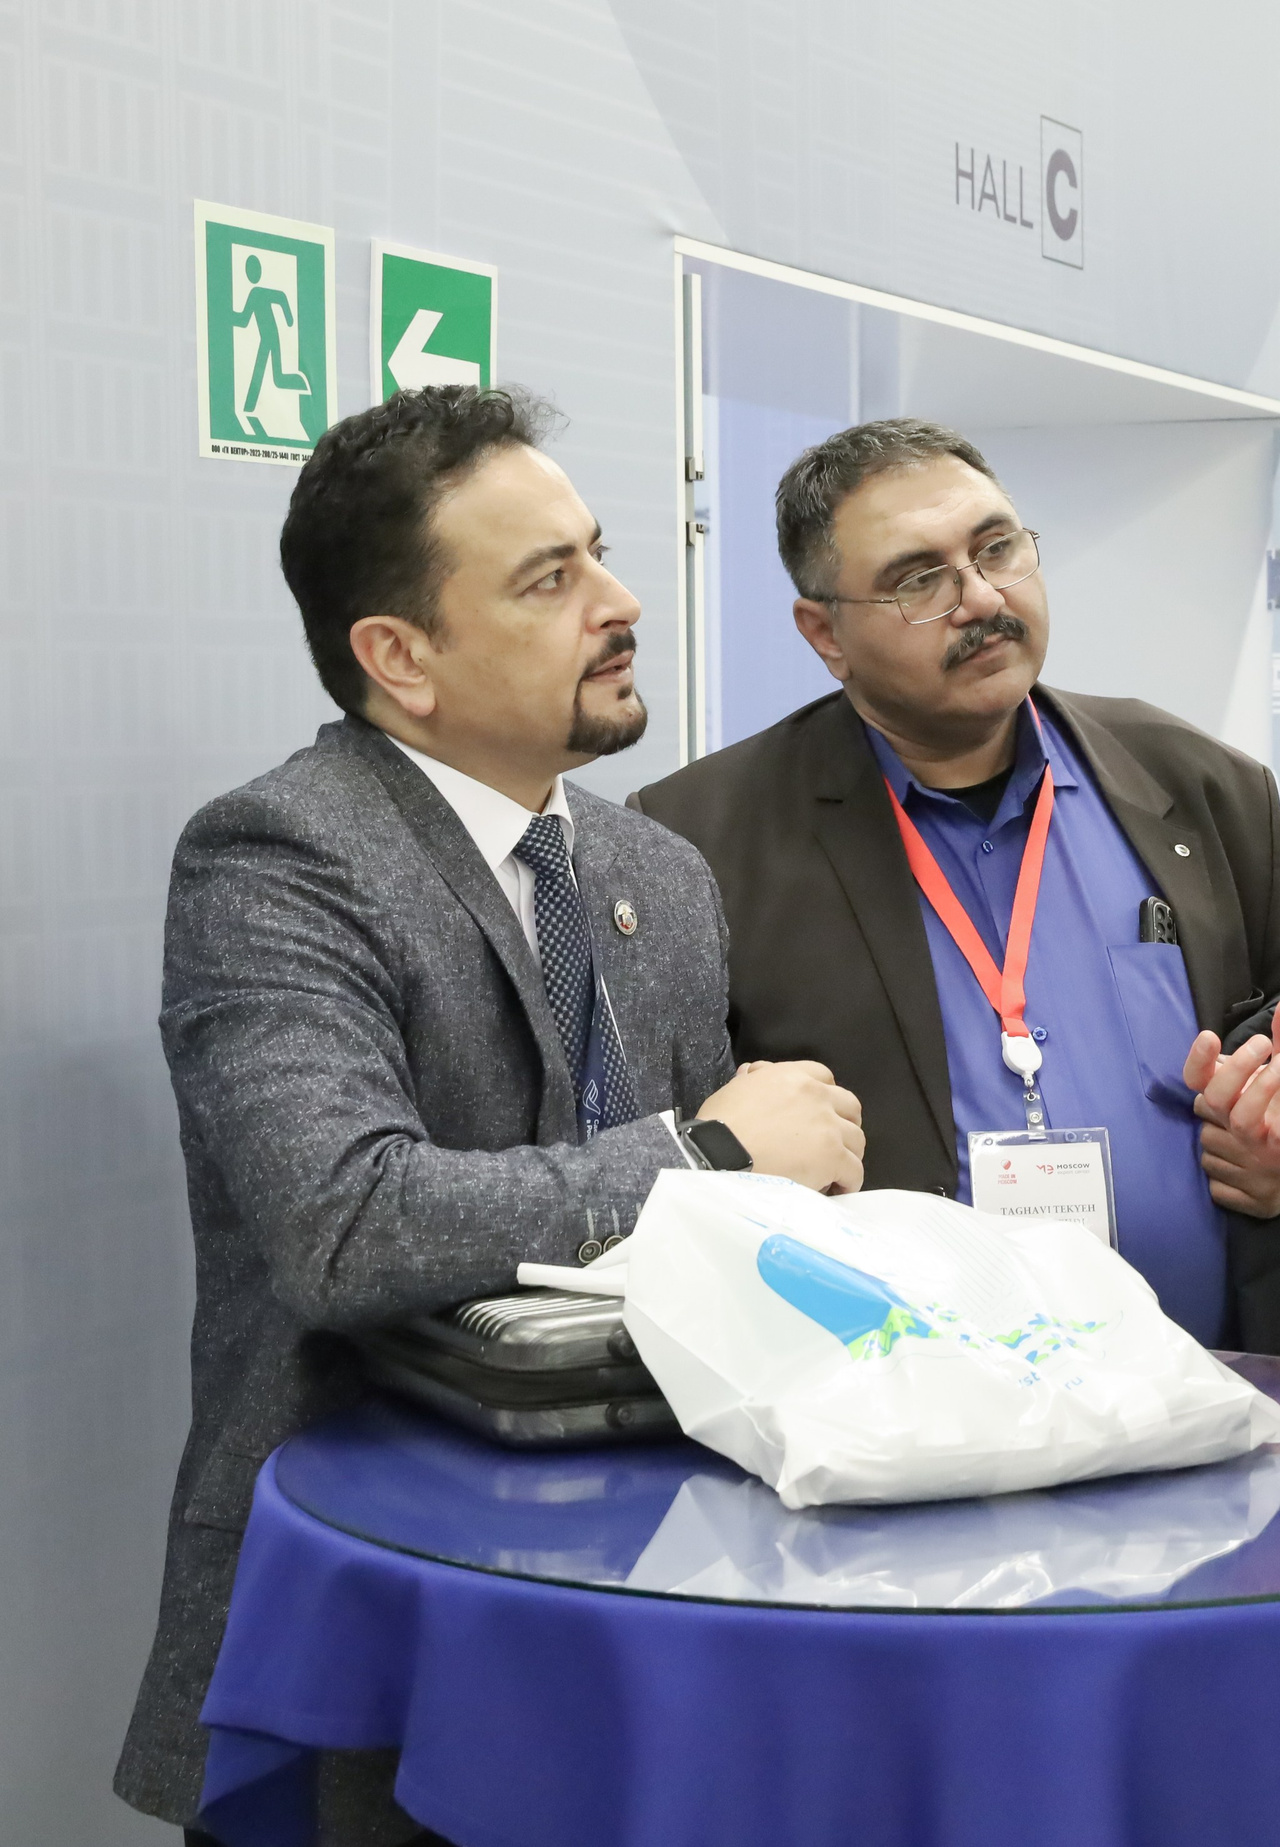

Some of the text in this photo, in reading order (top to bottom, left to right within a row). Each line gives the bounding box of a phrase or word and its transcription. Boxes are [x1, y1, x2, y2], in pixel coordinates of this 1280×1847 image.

[955, 141, 1078, 242] HALL C
[1000, 1203, 1096, 1216] TAGHAVI TEKYEH
